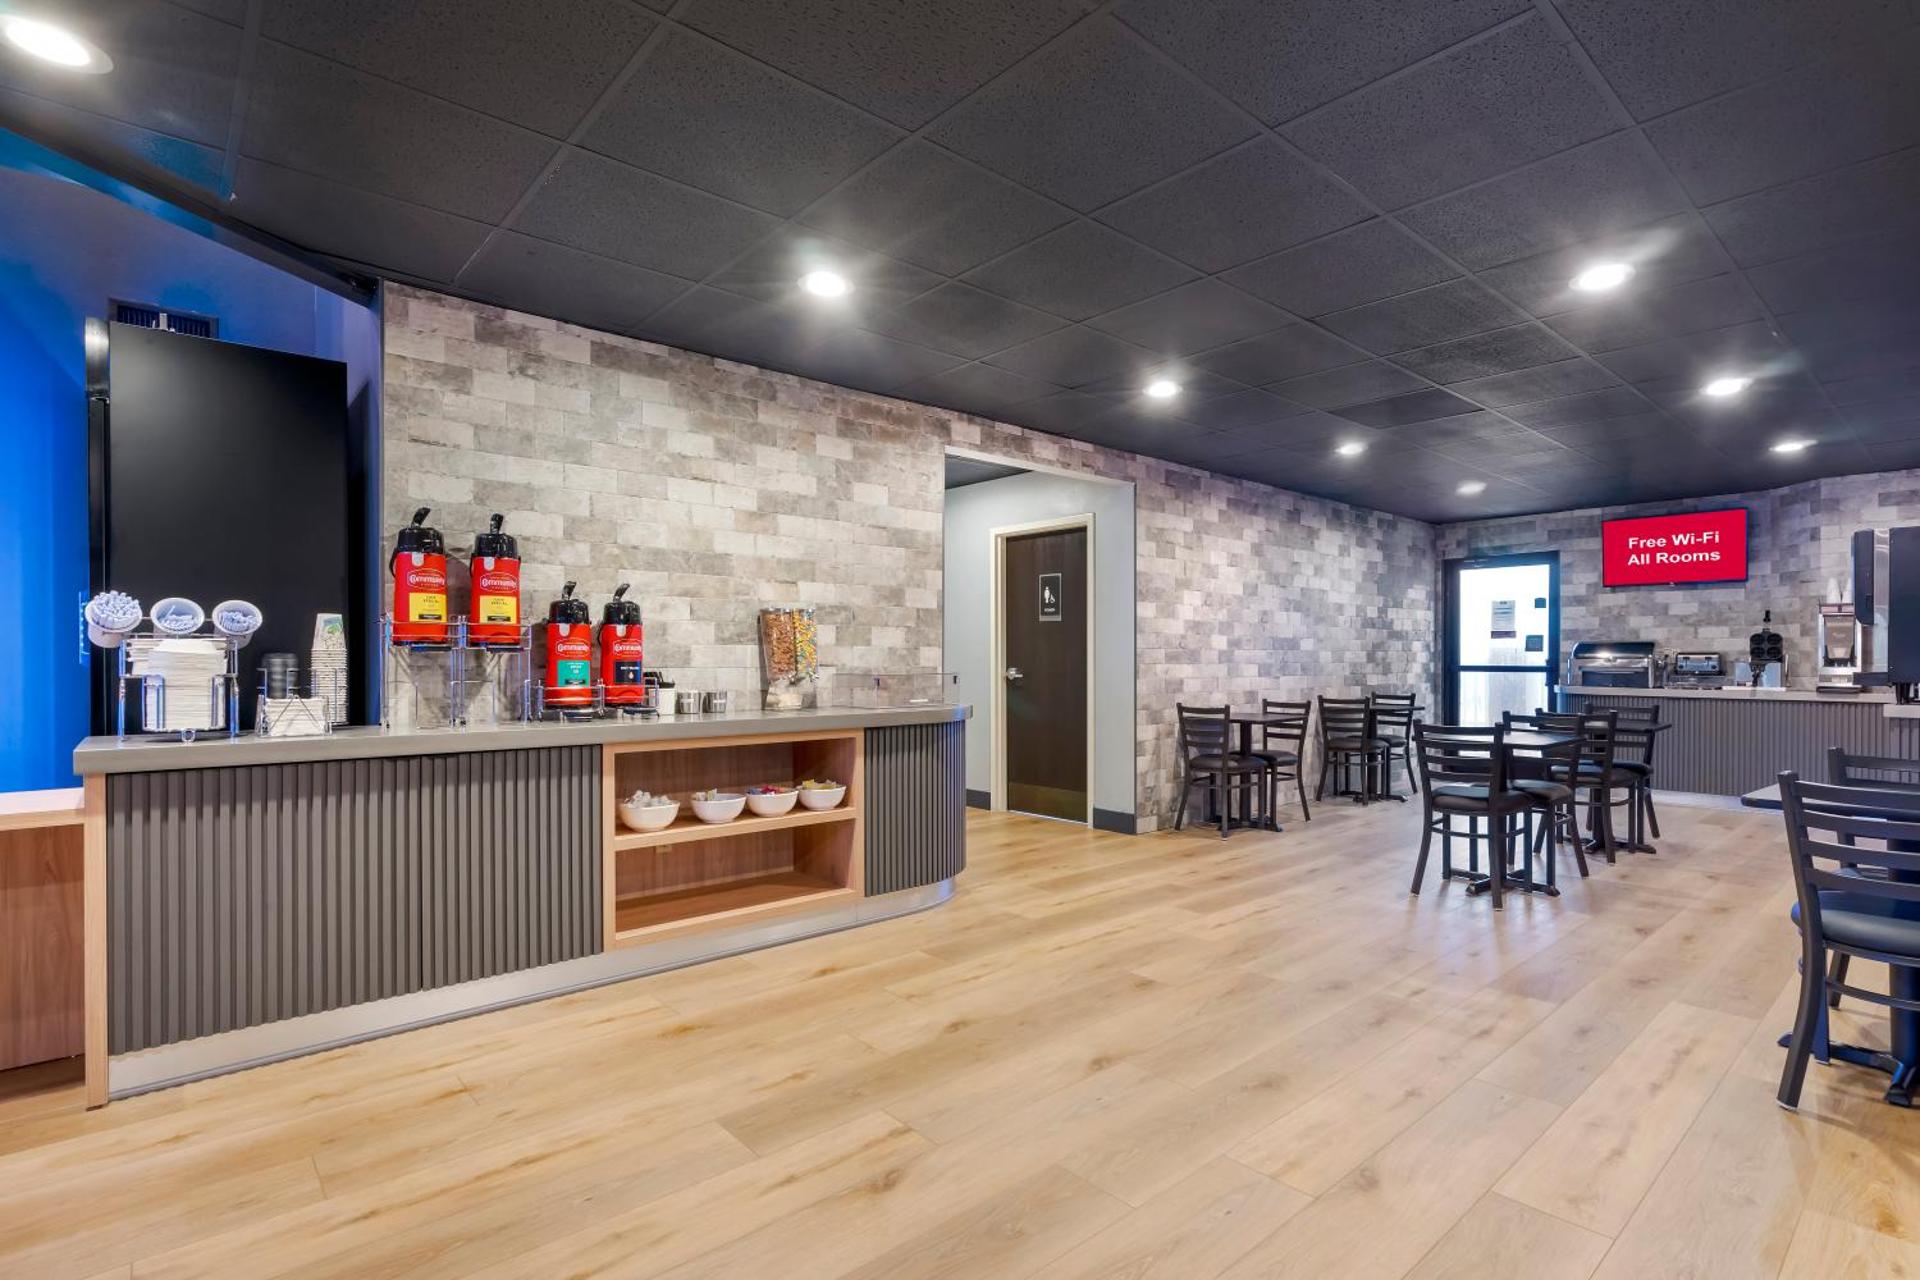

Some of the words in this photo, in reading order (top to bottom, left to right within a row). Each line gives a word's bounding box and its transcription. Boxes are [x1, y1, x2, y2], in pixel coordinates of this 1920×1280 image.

[1628, 537, 1667, 549] Free
[1672, 531, 1720, 546] Wi-Fi
[1627, 553, 1650, 566] All
[1656, 551, 1721, 564] Rooms
